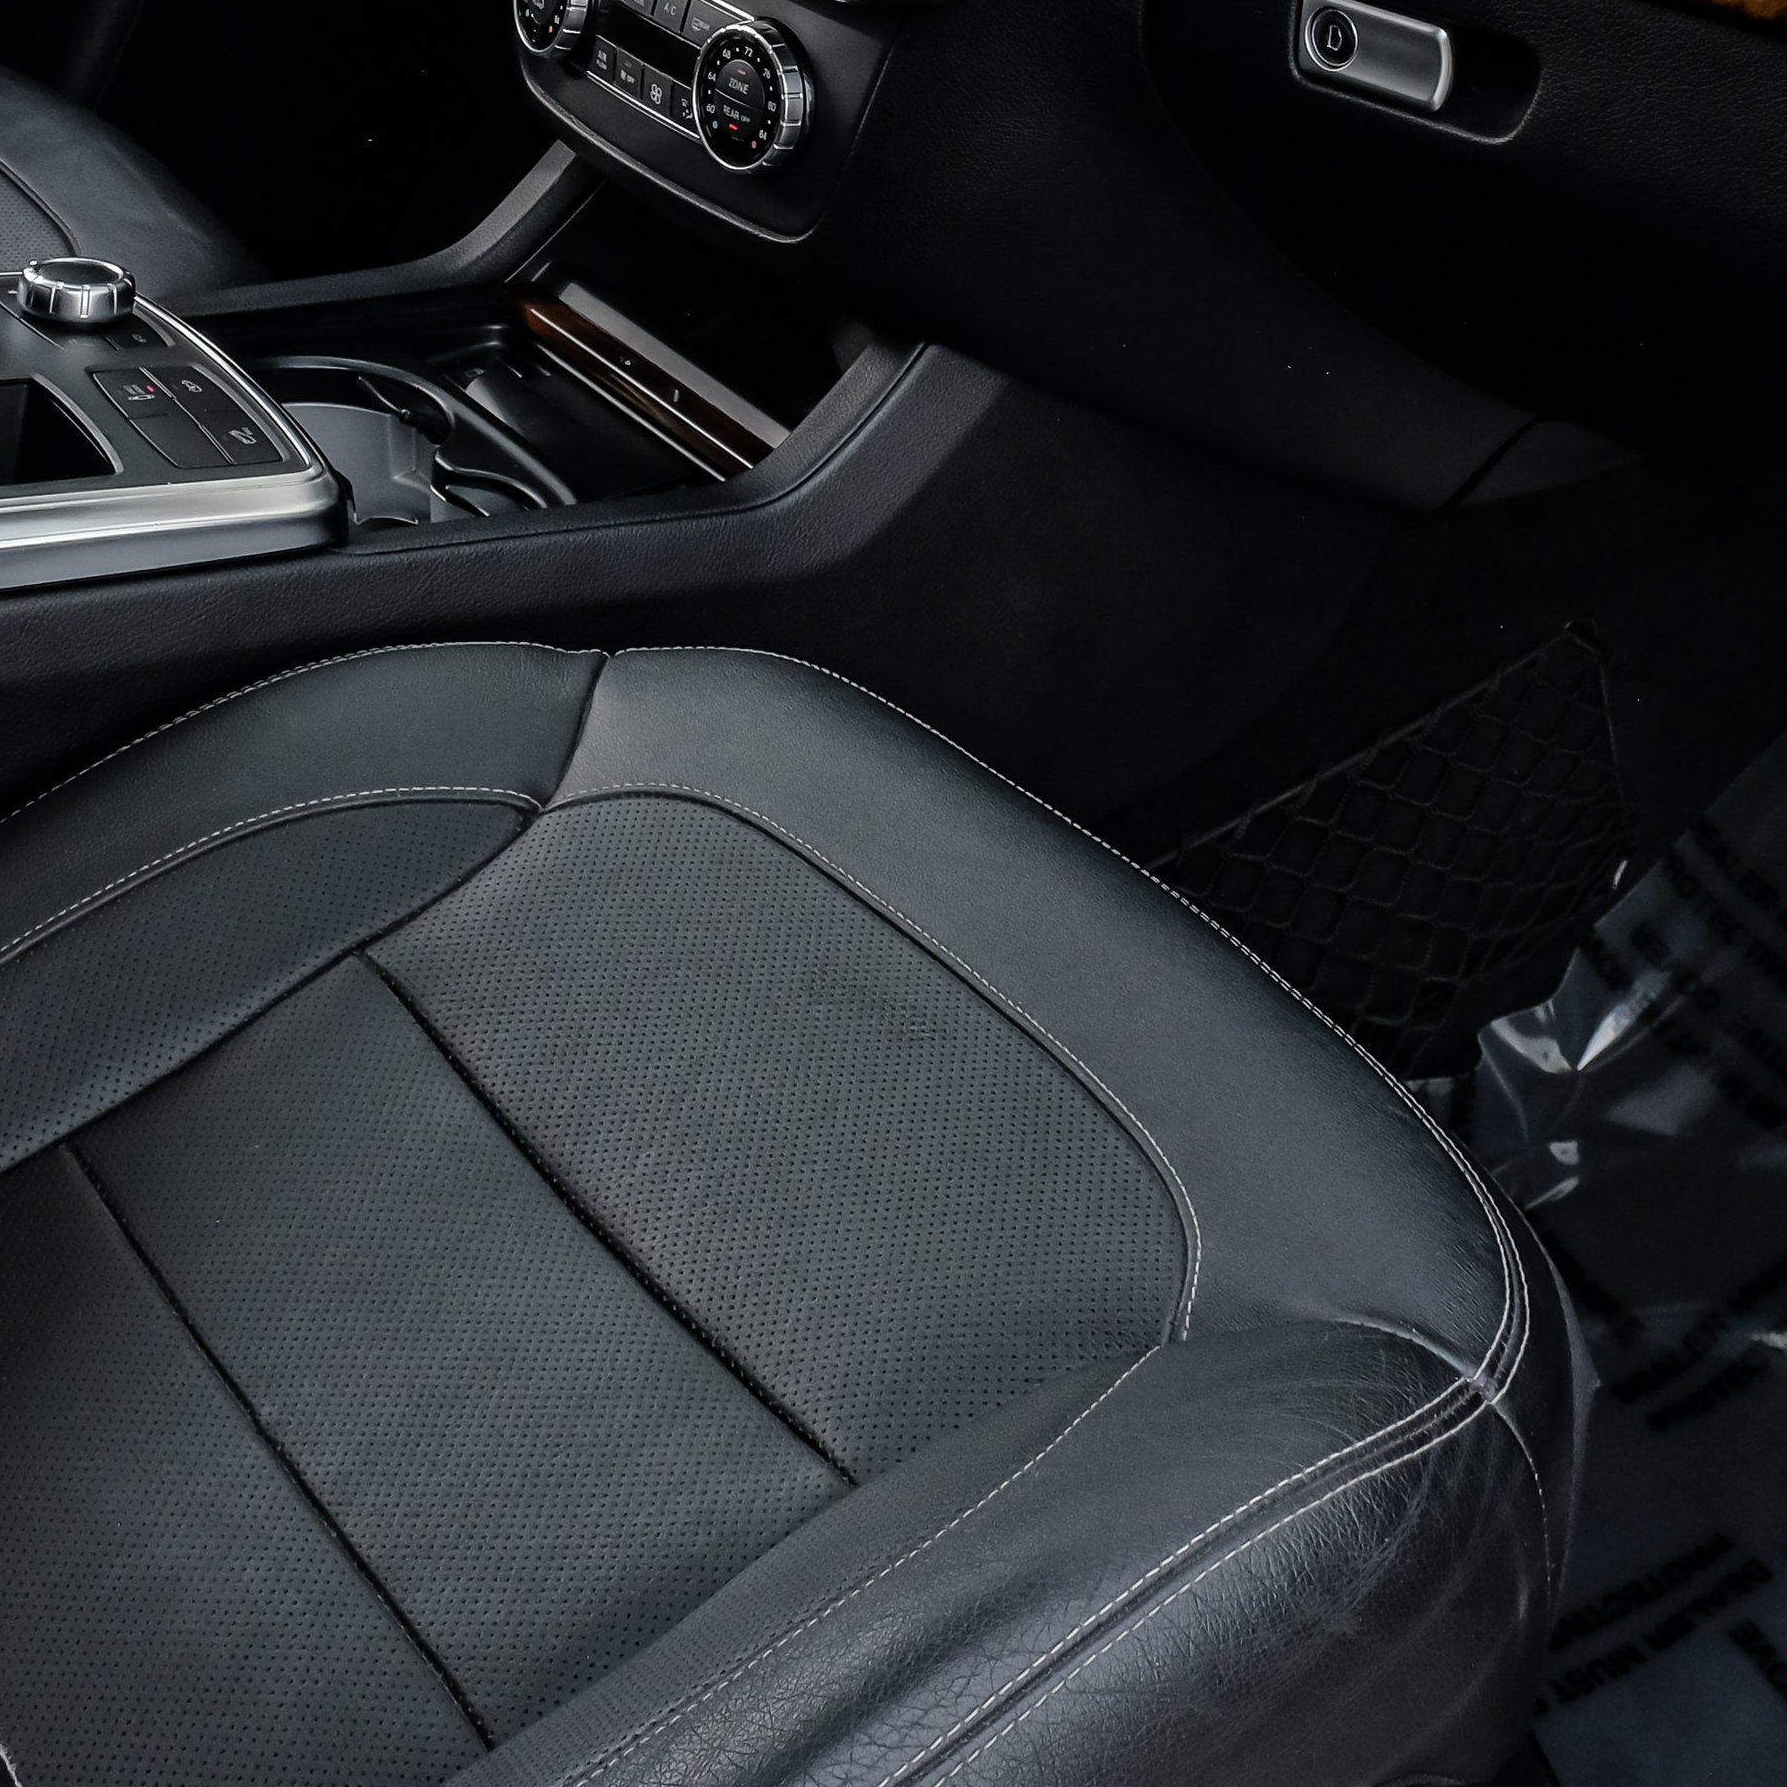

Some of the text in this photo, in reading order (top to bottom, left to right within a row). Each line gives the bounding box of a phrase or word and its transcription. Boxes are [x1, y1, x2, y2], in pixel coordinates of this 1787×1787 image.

[722, 48, 731, 59] 68
[744, 46, 753, 58] 72
[707, 71, 716, 82] 64
[762, 67, 771, 79] 76
[728, 77, 750, 95] ZONE
[706, 103, 715, 114] 60
[767, 100, 777, 112] 80
[723, 104, 740, 121] REAR
[1548, 1563, 1771, 1704] DEALER MUST
